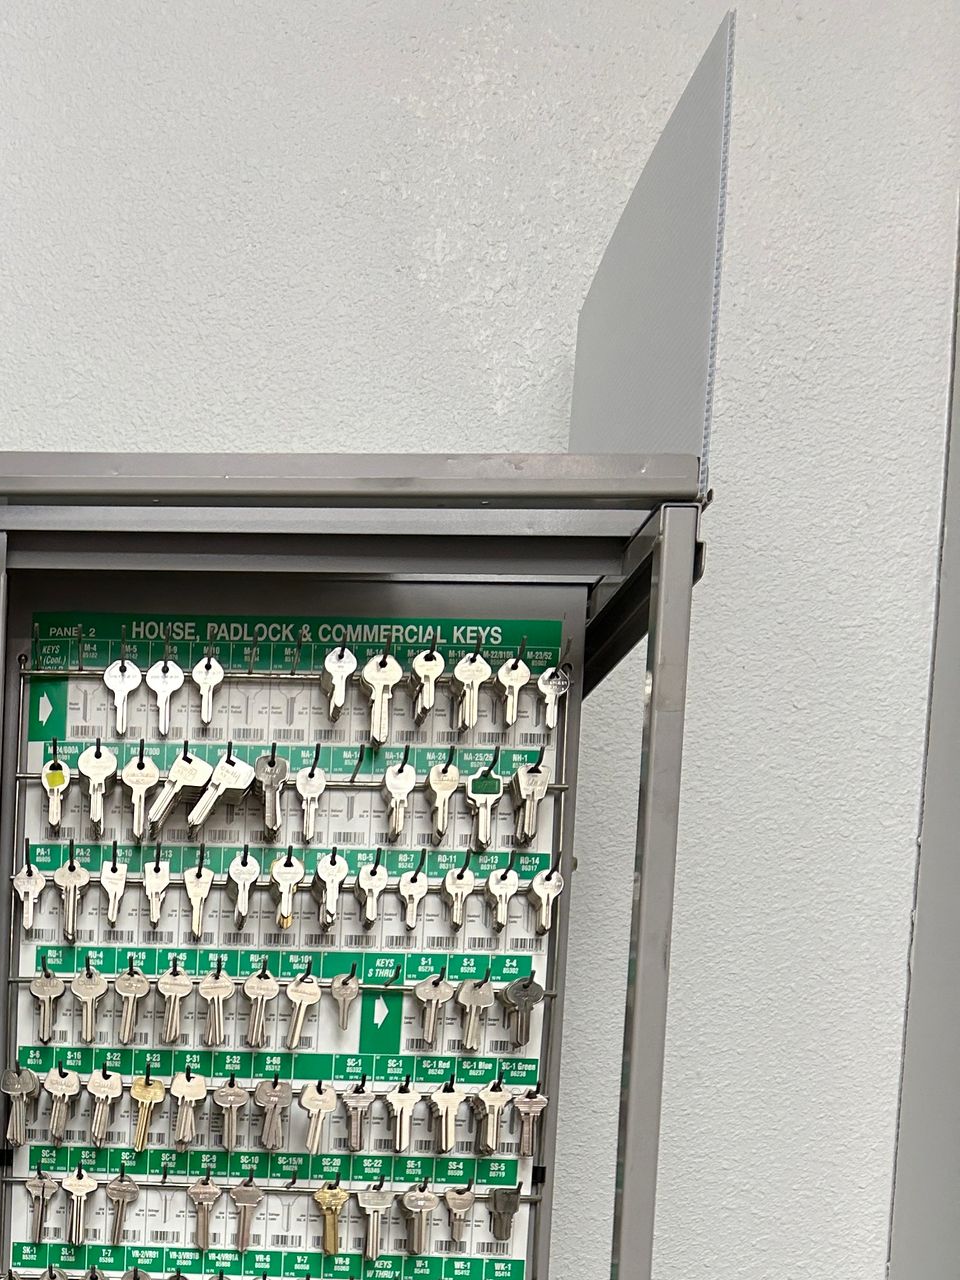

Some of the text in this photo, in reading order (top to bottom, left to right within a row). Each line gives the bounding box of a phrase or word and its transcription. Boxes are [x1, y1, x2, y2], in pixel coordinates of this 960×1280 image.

[49, 628, 96, 637] PANE 2
[132, 622, 502, 644] HOUSE, PADLOCK & COMMERCIAL KEYS
[42, 645, 60, 653] KEYS
[399, 854, 414, 862] RO-7
[376, 959, 394, 967] KEYS
[463, 958, 474, 966] S-3
[375, 969, 394, 977] THRU
[347, 1058, 361, 1066] SC-1
[438, 1061, 450, 1069] Red
[462, 1061, 492, 1070] SC-1 Blue
[121, 1152, 135, 1160] SC-7
[23, 1246, 36, 1254] SK-1
[375, 1270, 394, 1278] THRU
